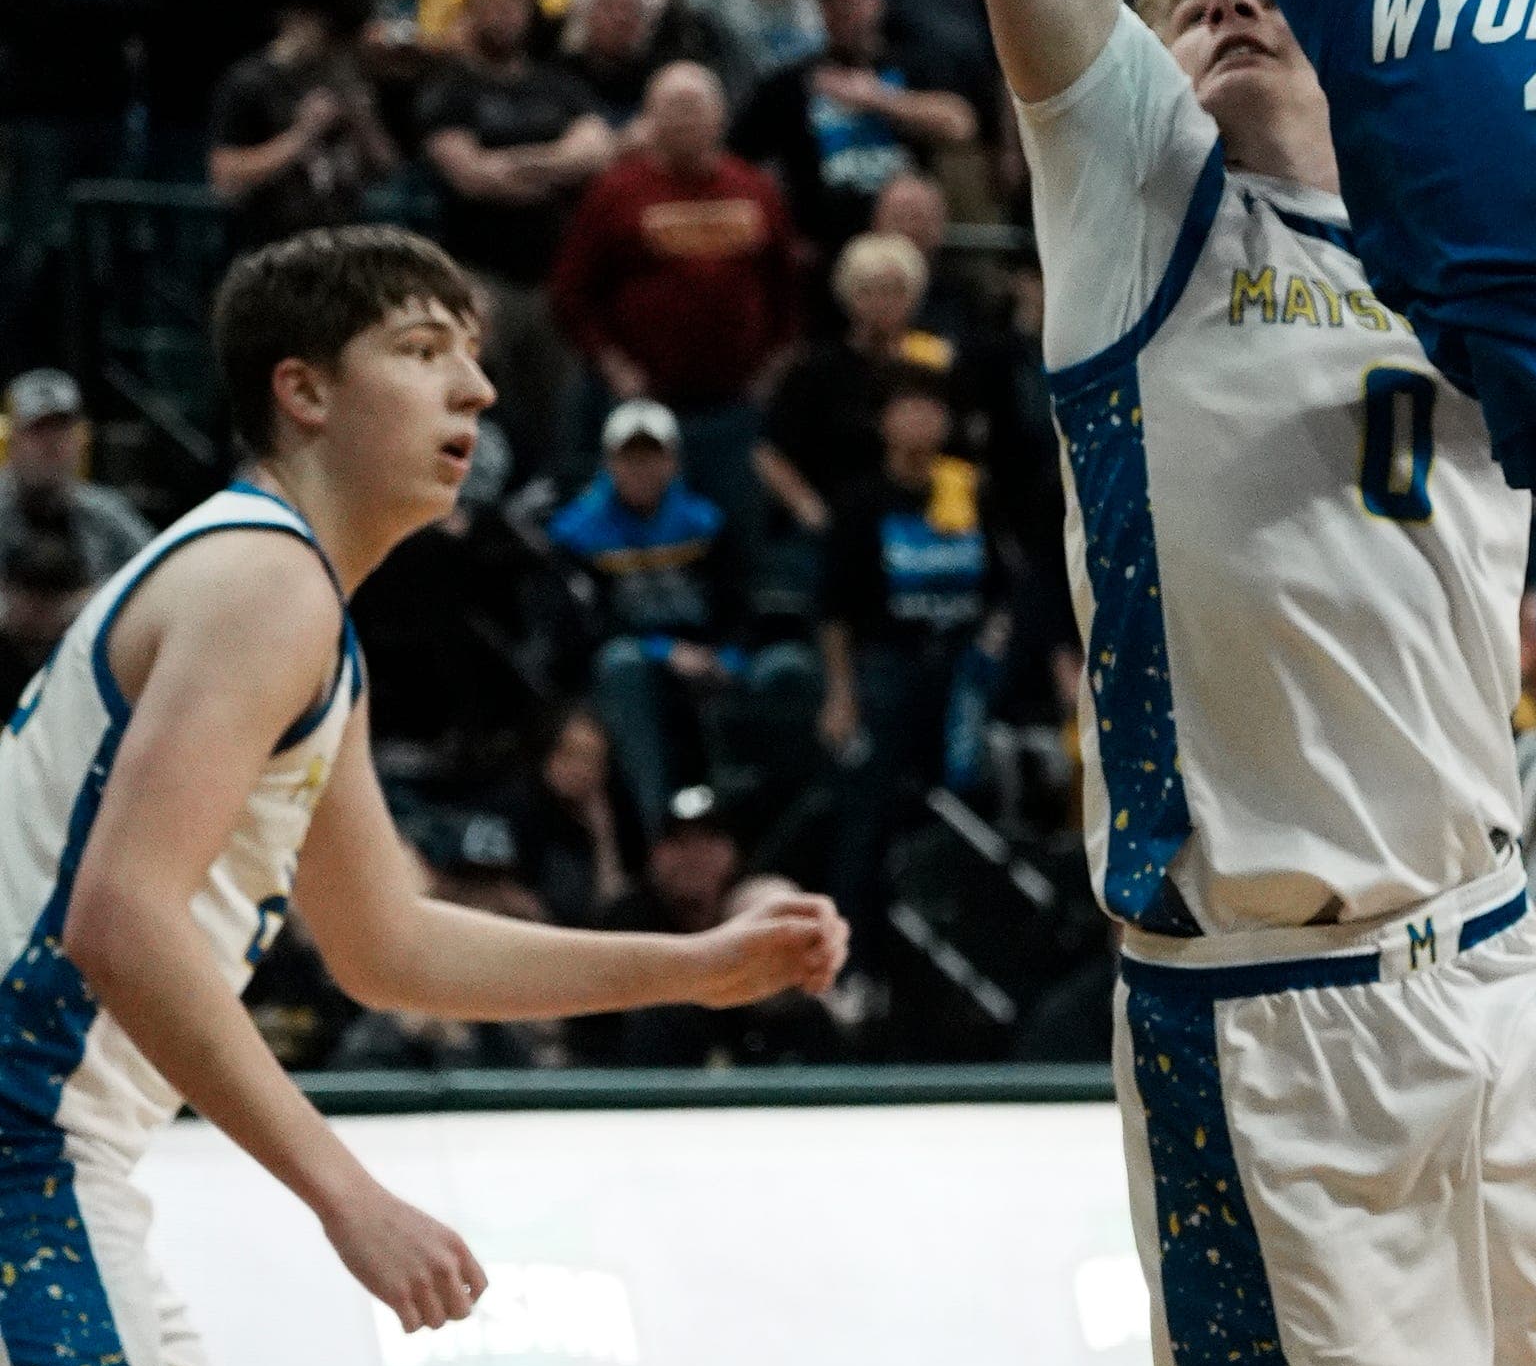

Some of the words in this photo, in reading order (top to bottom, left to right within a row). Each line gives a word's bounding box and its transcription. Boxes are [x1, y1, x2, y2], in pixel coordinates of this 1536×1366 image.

[1229, 266, 1414, 332] MAYS
[1359, 363, 1435, 522] 0
[1407, 917, 1436, 969] M
